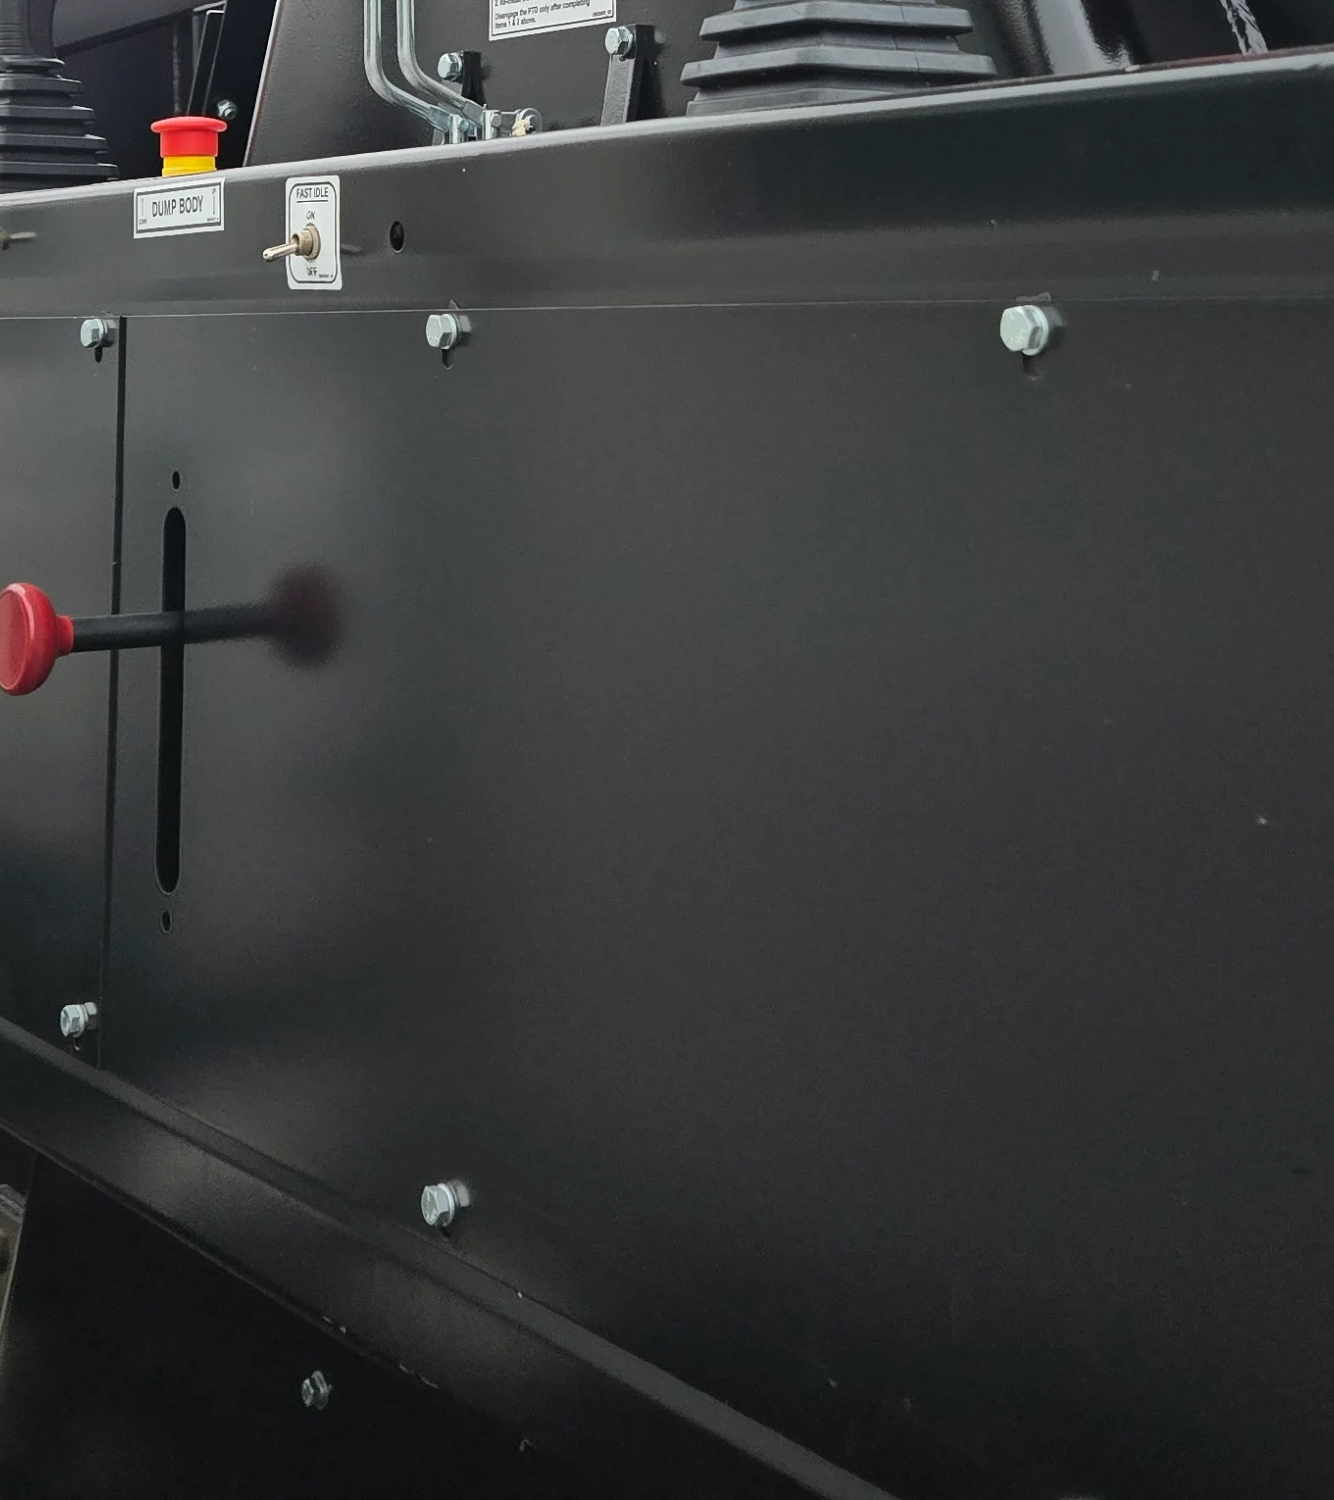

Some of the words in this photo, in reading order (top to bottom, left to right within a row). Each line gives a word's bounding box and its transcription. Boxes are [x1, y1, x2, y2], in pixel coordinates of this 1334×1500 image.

[528, 5, 538, 14] PTO
[540, 5, 549, 14] only
[550, 1, 562, 11] after
[296, 188, 312, 198] FAST
[314, 187, 328, 197] IDLE
[152, 199, 176, 217] DUMP
[180, 195, 203, 214] BODY
[306, 211, 315, 219] ON
[307, 267, 317, 276] OFF
